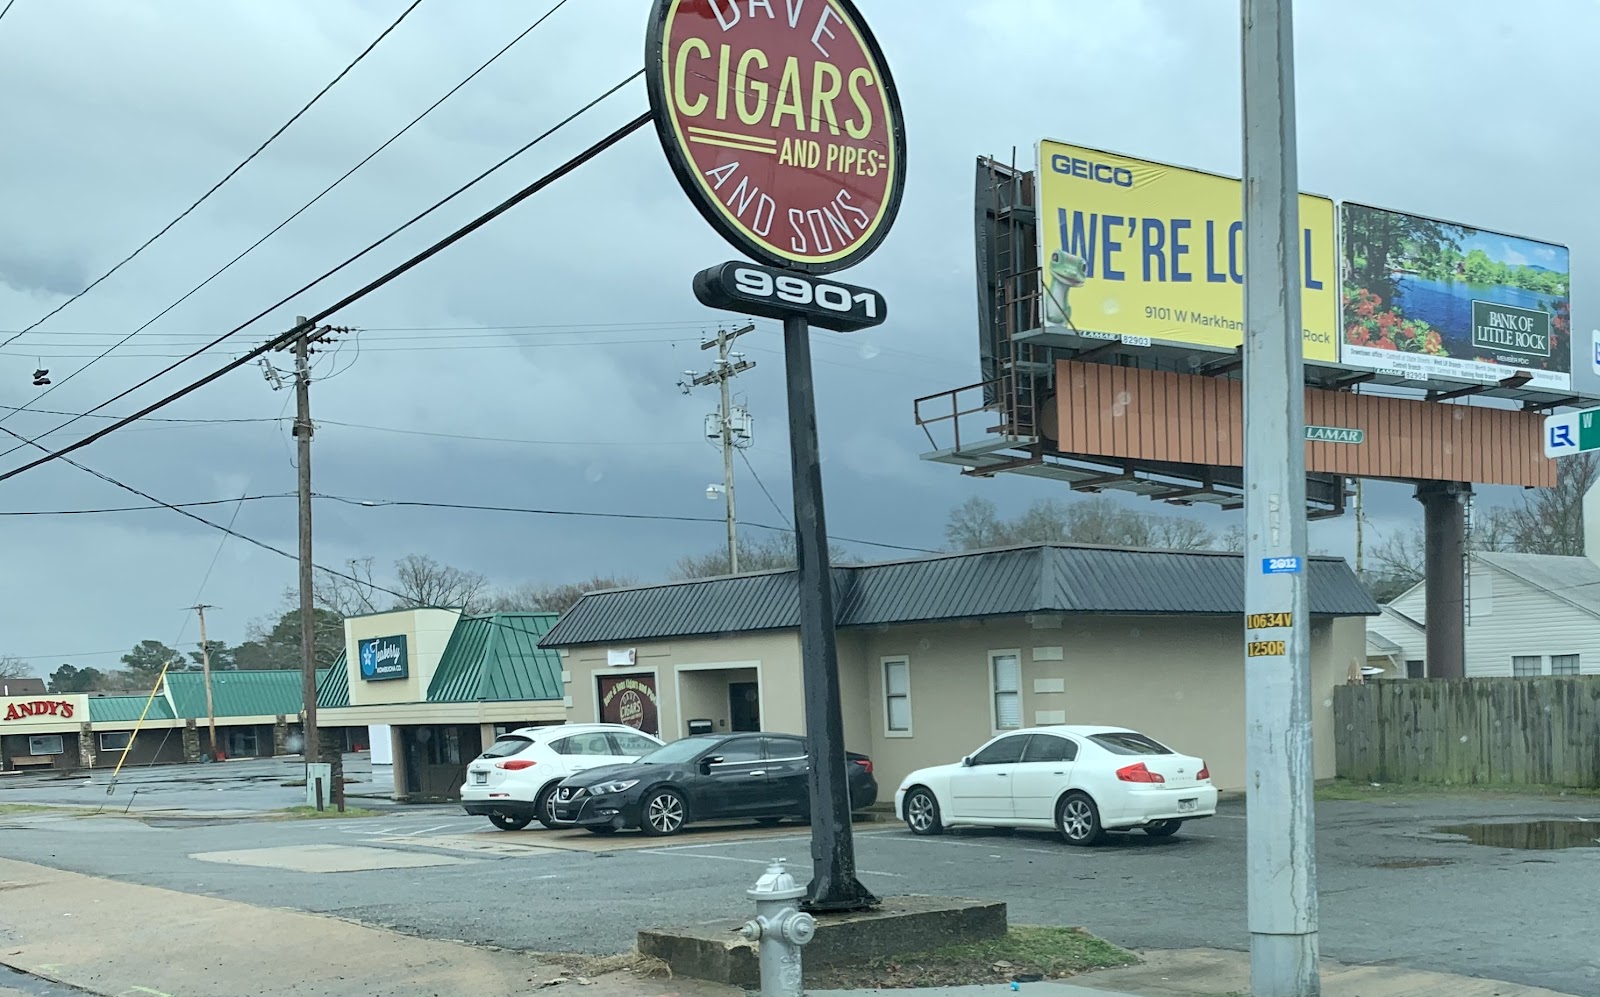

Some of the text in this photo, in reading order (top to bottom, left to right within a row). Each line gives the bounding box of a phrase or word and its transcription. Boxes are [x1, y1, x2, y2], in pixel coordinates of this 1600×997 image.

[674, 37, 874, 139] CIGARS
[779, 137, 878, 177] AND PIPES
[1052, 154, 1132, 187] GEICO
[705, 161, 869, 253] AND SONS
[1058, 207, 1323, 290] WE'RE LOL
[735, 267, 876, 318] 9901
[1145, 306, 1170, 320] 9101
[1174, 309, 1188, 322] W
[1489, 311, 1534, 332] BANK OF
[1083, 331, 1115, 340] LAMAR
[1123, 335, 1148, 346] 82903
[1303, 329, 1331, 344] Rock
[1477, 326, 1546, 350] LITTLE ROCK
[1405, 371, 1427, 380] 82904
[1583, 412, 1593, 428] W
[1307, 428, 1358, 441] LAMAR
[1269, 558, 1297, 570] 2012
[1247, 613, 1292, 629] 10634V
[1248, 641, 1285, 657] 1250R
[4, 701, 74, 721] ANDY'S
[621, 701, 641, 718] CIGARS
